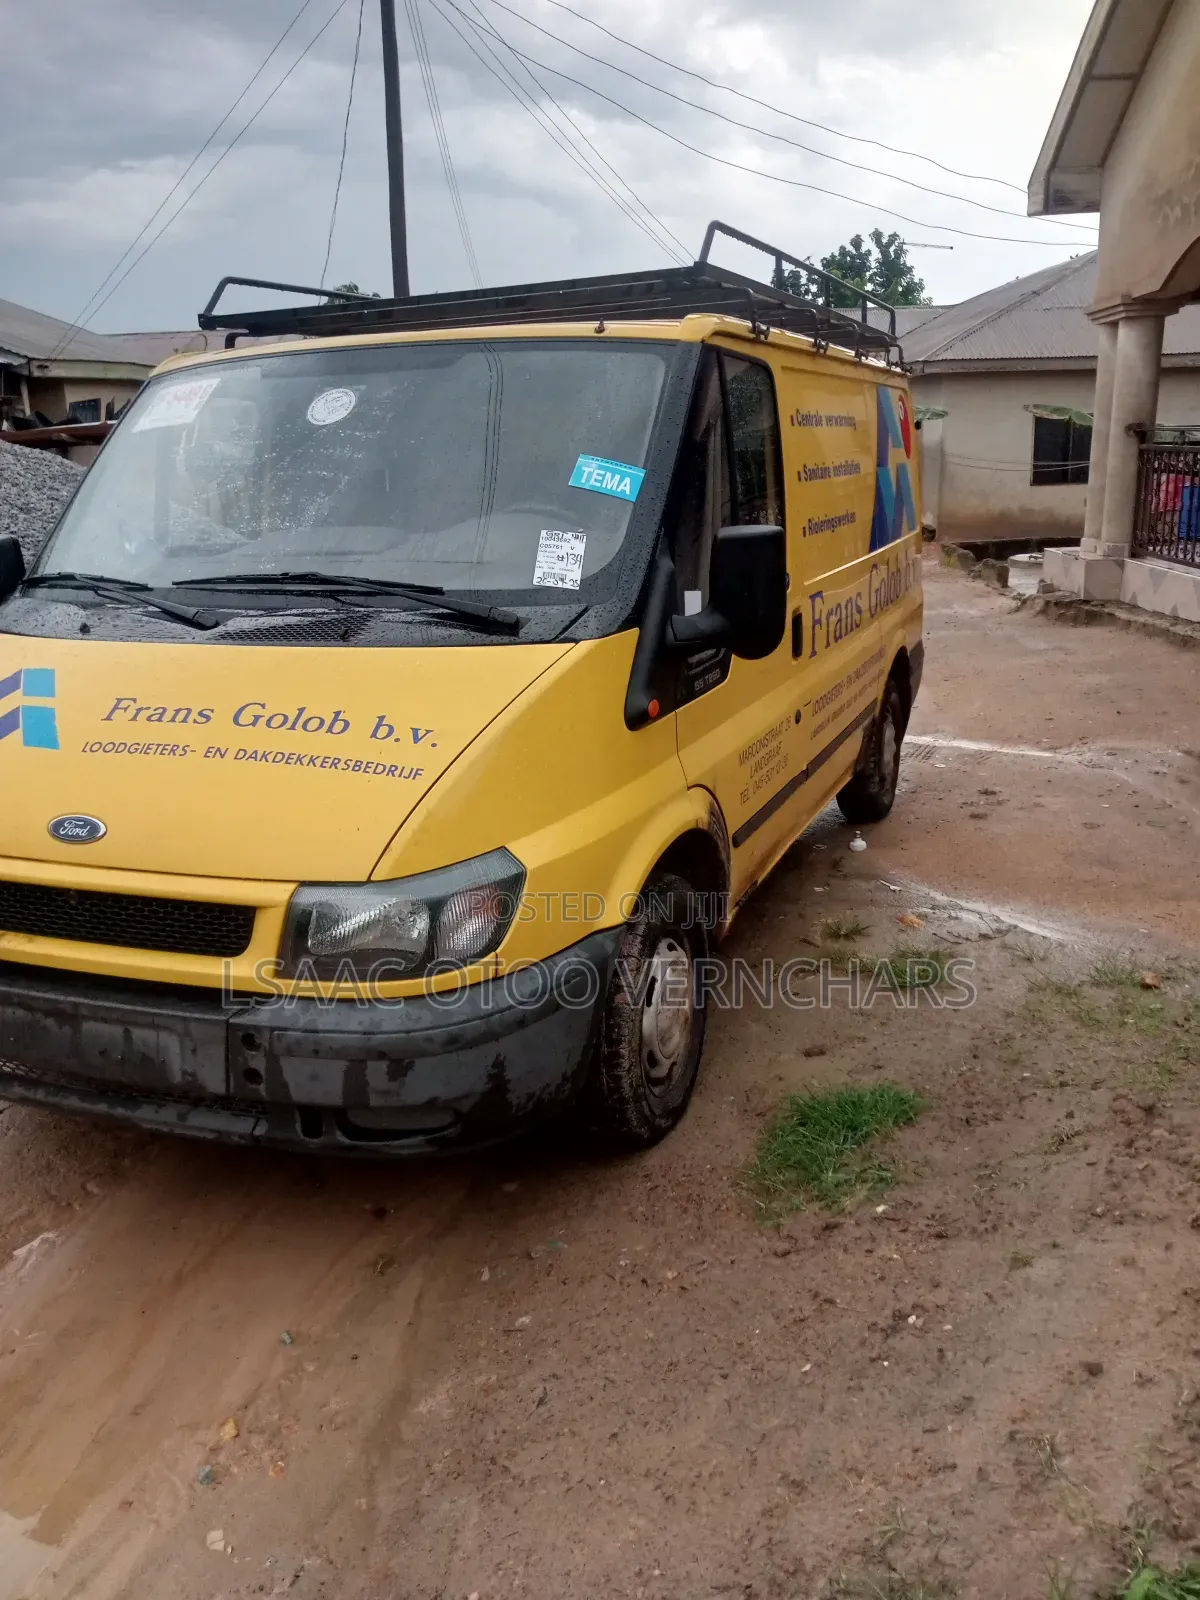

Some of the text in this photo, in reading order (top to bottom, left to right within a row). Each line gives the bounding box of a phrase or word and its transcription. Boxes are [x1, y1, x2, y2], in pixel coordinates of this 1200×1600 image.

[795, 408, 857, 431] Centrale verwarming
[580, 466, 632, 496] TEMA
[803, 462, 832, 482] Sanitaire
[808, 590, 862, 660] Frans
[868, 552, 902, 618] Golob
[100, 696, 439, 748] Frans Golob b.v.
[81, 740, 425, 782] LOODGIETERS- EN DAKDEKKERSBEDRIJF
[59, 819, 91, 837] Ford
